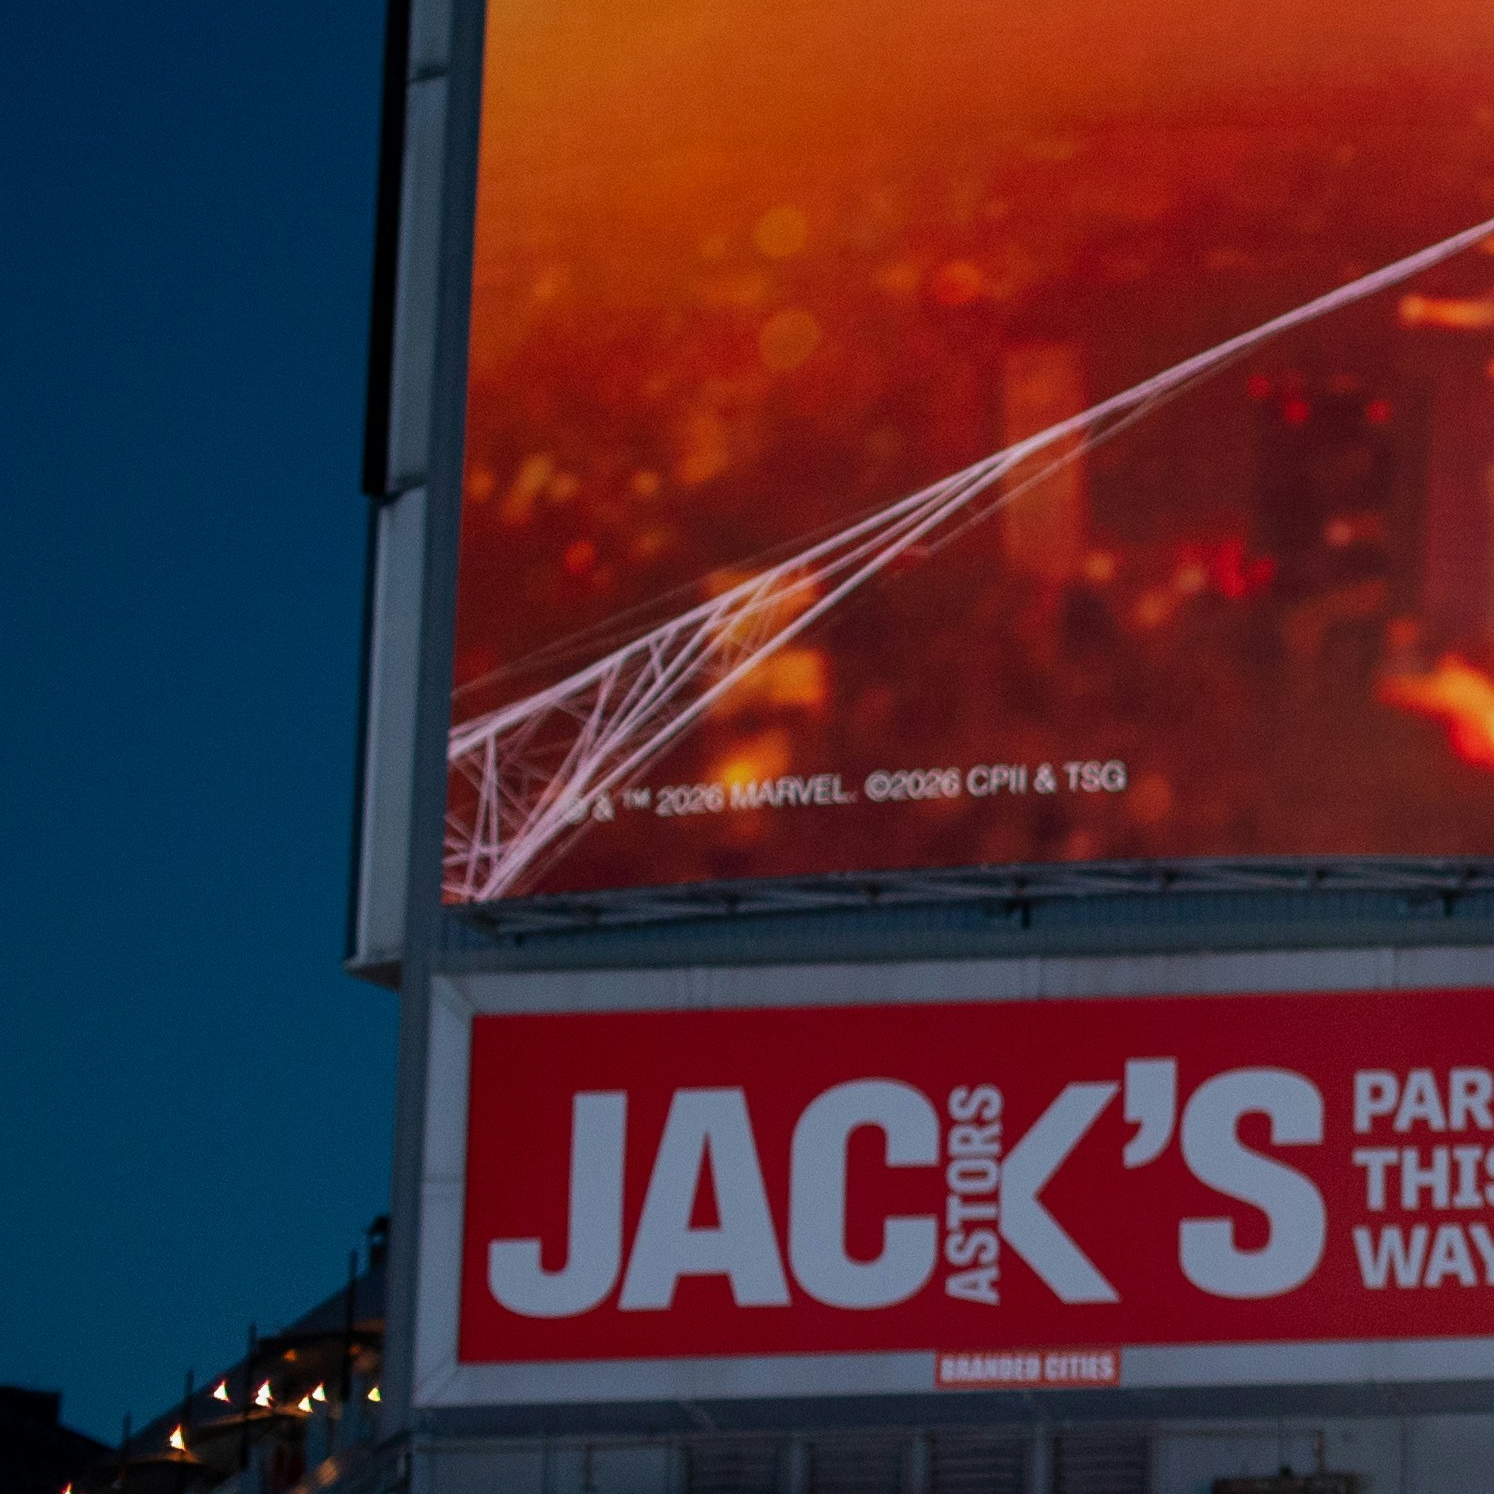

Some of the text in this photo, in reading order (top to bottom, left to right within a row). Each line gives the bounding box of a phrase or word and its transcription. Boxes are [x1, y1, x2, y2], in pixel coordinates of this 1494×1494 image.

[1033, 762, 1057, 795] &
[1062, 759, 1128, 793] TSG
[486, 1057, 1328, 1319] JACK'S
[945, 1082, 1003, 1306] ASTORS
